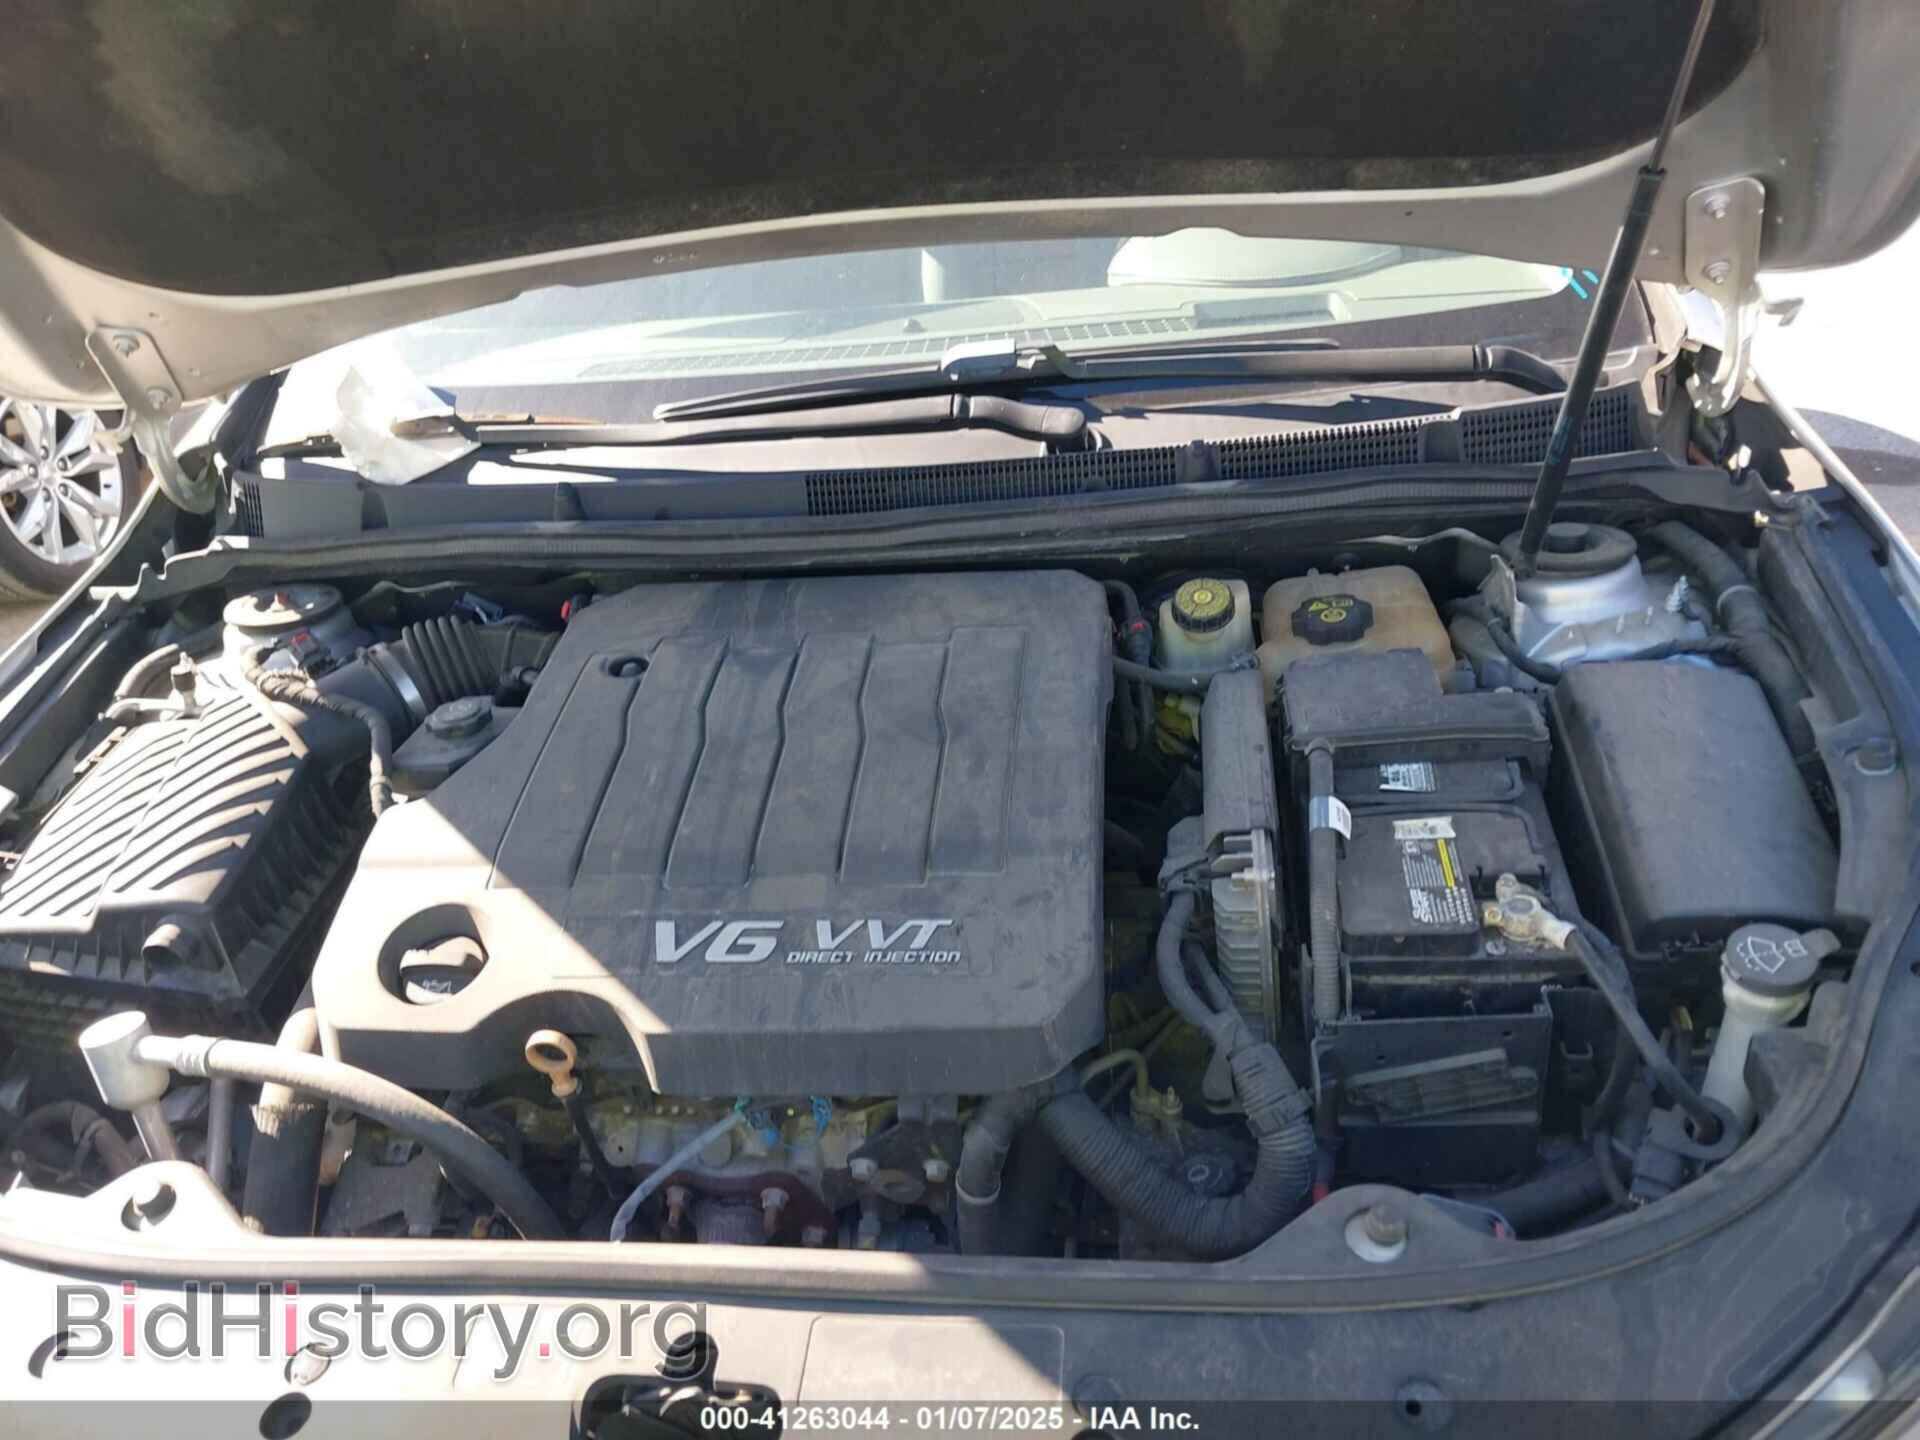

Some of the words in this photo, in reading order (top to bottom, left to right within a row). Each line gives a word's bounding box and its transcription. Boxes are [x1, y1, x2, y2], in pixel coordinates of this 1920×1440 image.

[655, 920, 784, 963] V6
[816, 919, 953, 950] VVT
[786, 951, 854, 964] DIRECT
[863, 951, 961, 964] INJECTION
